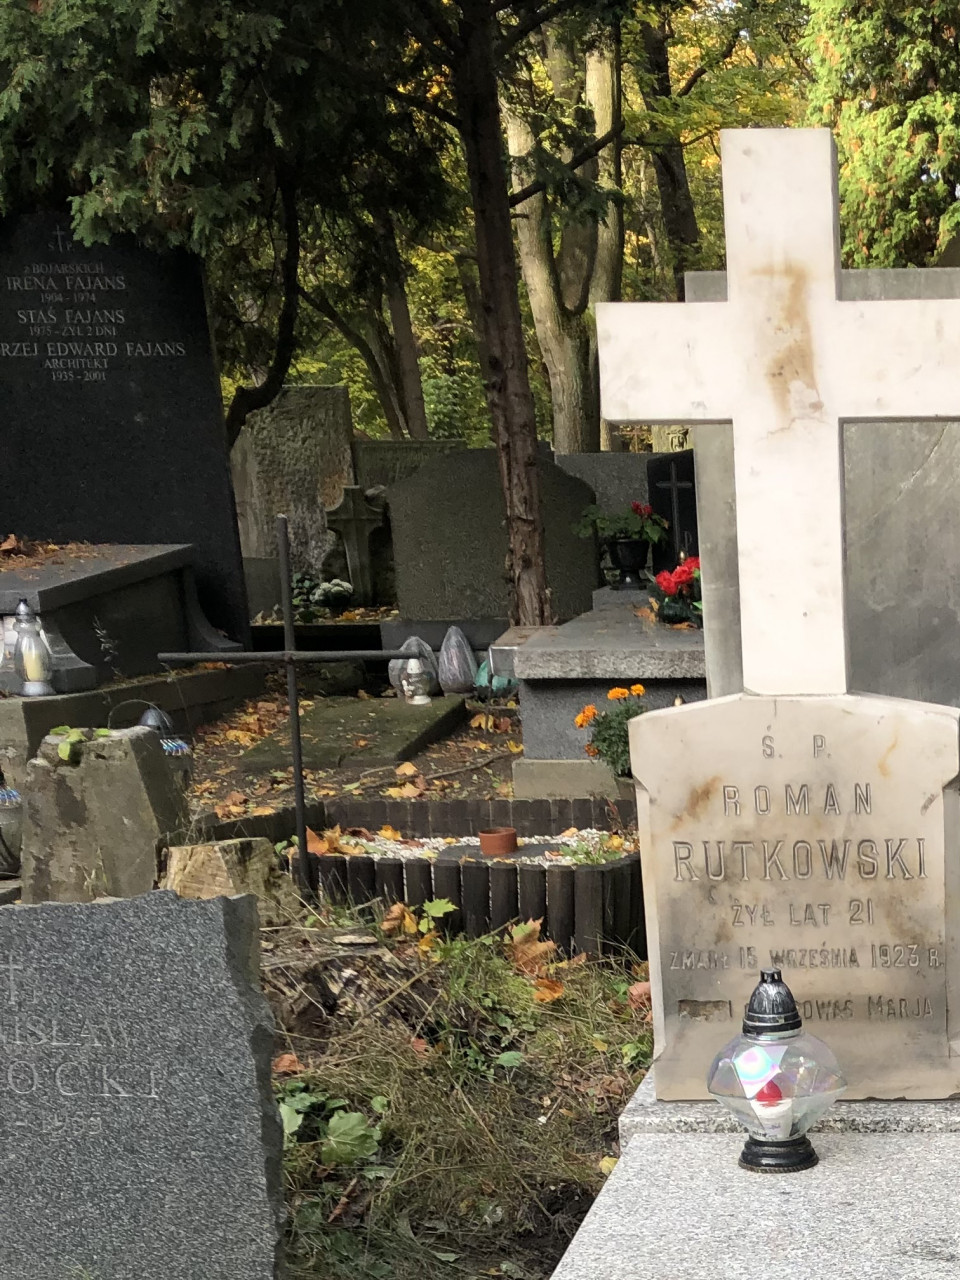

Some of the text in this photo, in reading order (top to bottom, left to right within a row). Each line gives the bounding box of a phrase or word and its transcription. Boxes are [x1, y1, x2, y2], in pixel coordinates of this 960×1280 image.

[6, 276, 126, 290] IRENA FAJANS
[65, 309, 125, 324] FAJANS
[95, 326, 117, 336] DNI
[47, 342, 118, 356] EDWARD
[125, 342, 186, 356] FAJANS
[44, 358, 109, 369] ARCHITEKT
[722, 782, 873, 817] ROMAN
[672, 837, 930, 882] RUTKOWSKI
[731, 896, 875, 928] ŻYŁ LAT 21
[738, 945, 758, 970] 15
[871, 943, 920, 969] 1923
